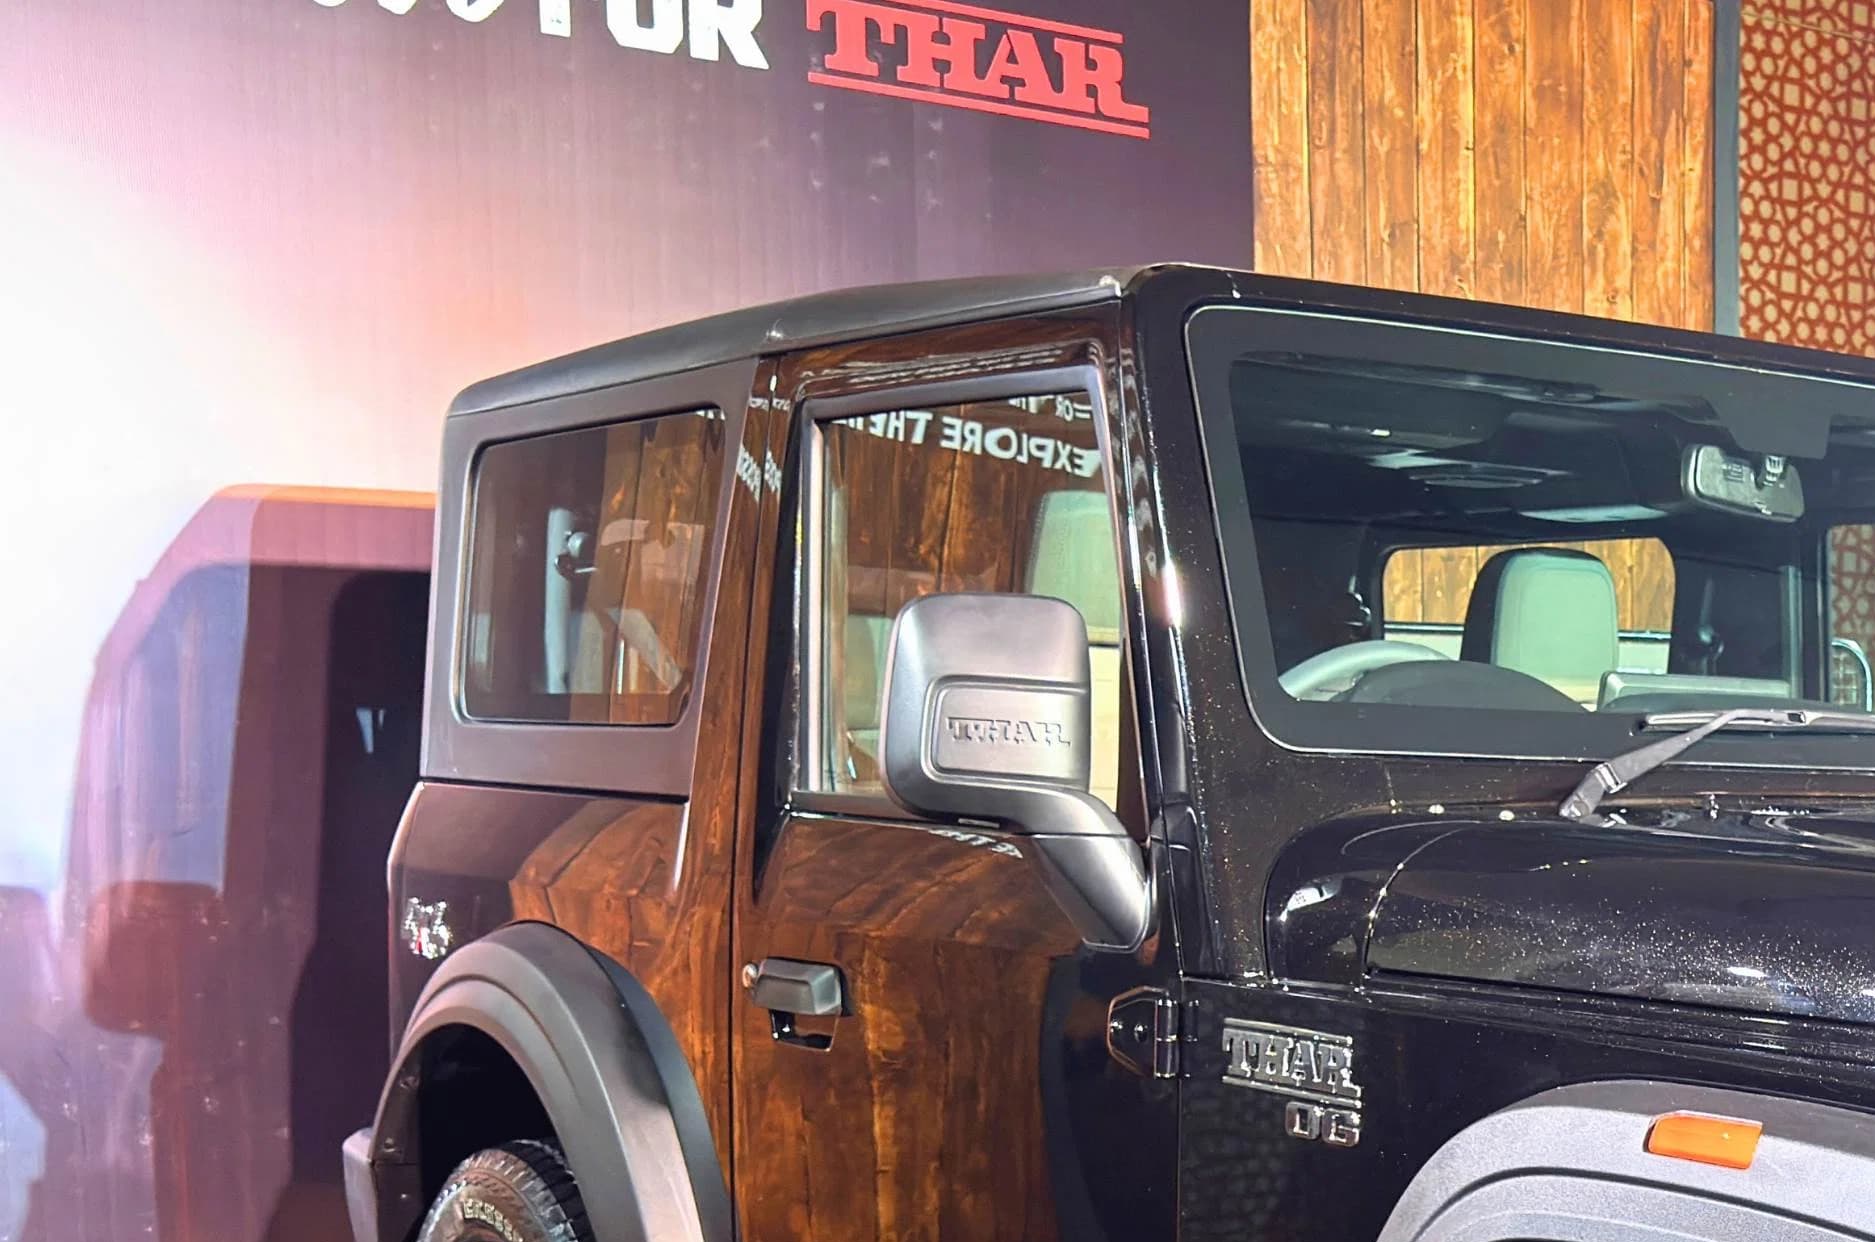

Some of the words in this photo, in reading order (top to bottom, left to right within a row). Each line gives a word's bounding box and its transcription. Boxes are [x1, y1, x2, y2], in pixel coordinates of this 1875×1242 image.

[806, 4, 1150, 123] THAR
[946, 716, 1071, 747] THAR
[1222, 1028, 1362, 1098] THAR
[1285, 1101, 1361, 1147] OG
